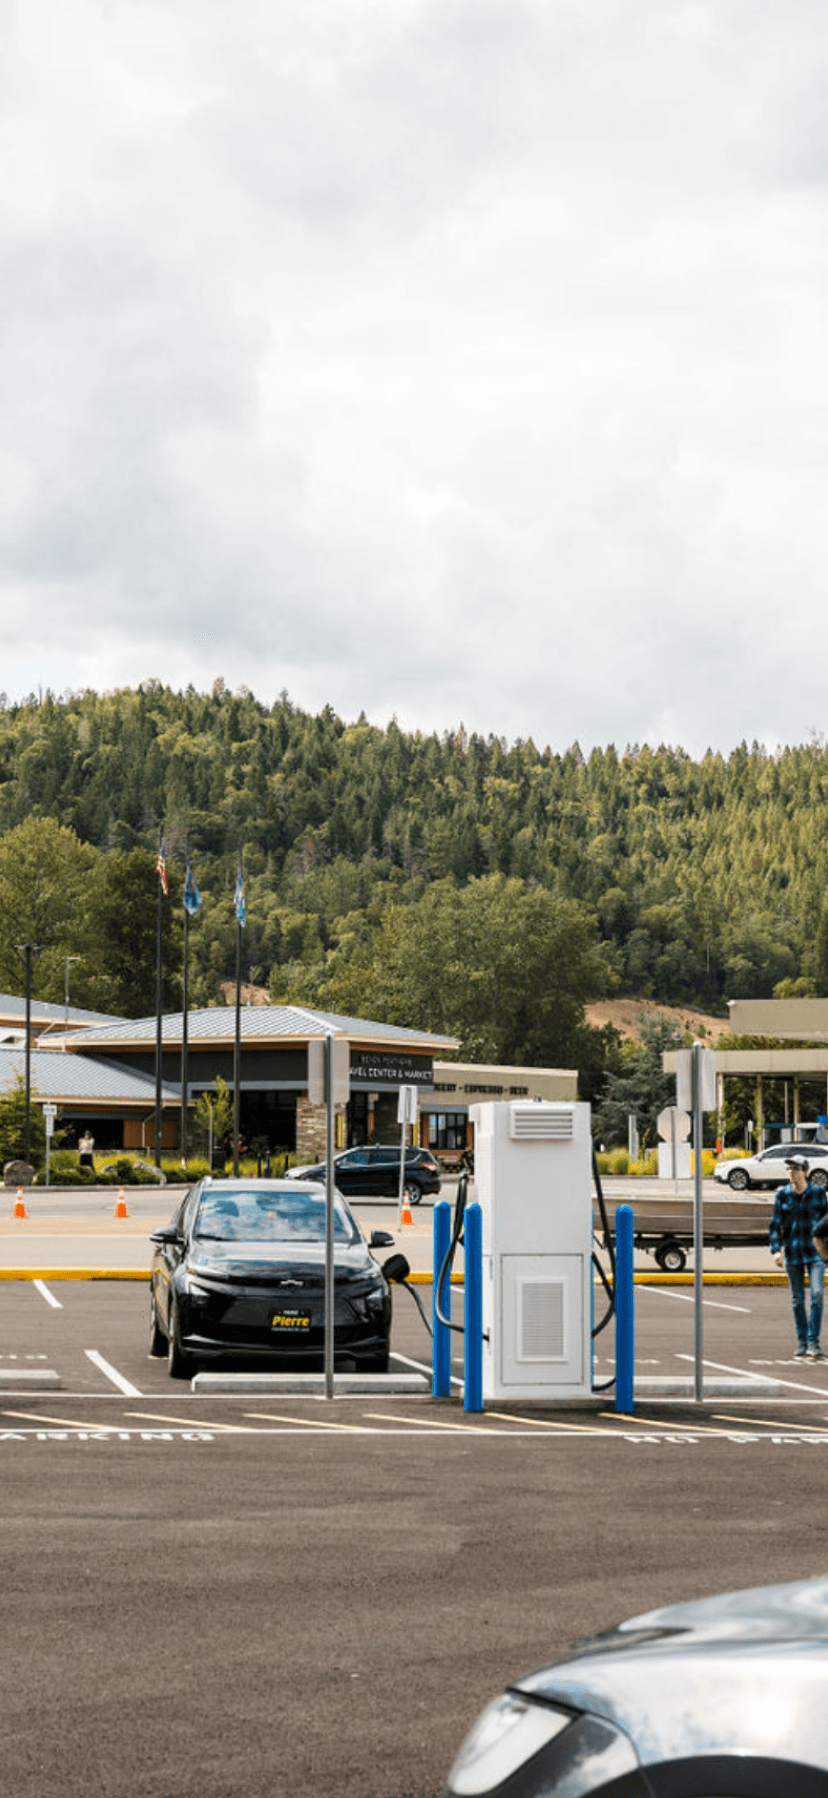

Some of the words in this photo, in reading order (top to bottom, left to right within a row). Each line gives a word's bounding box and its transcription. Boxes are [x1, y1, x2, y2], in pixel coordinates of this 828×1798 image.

[368, 1068, 397, 1078] CENTER
[404, 1070, 432, 1079] MARKET
[272, 1316, 309, 1327] Pierre
[0, 1432, 215, 1441] ARKING
